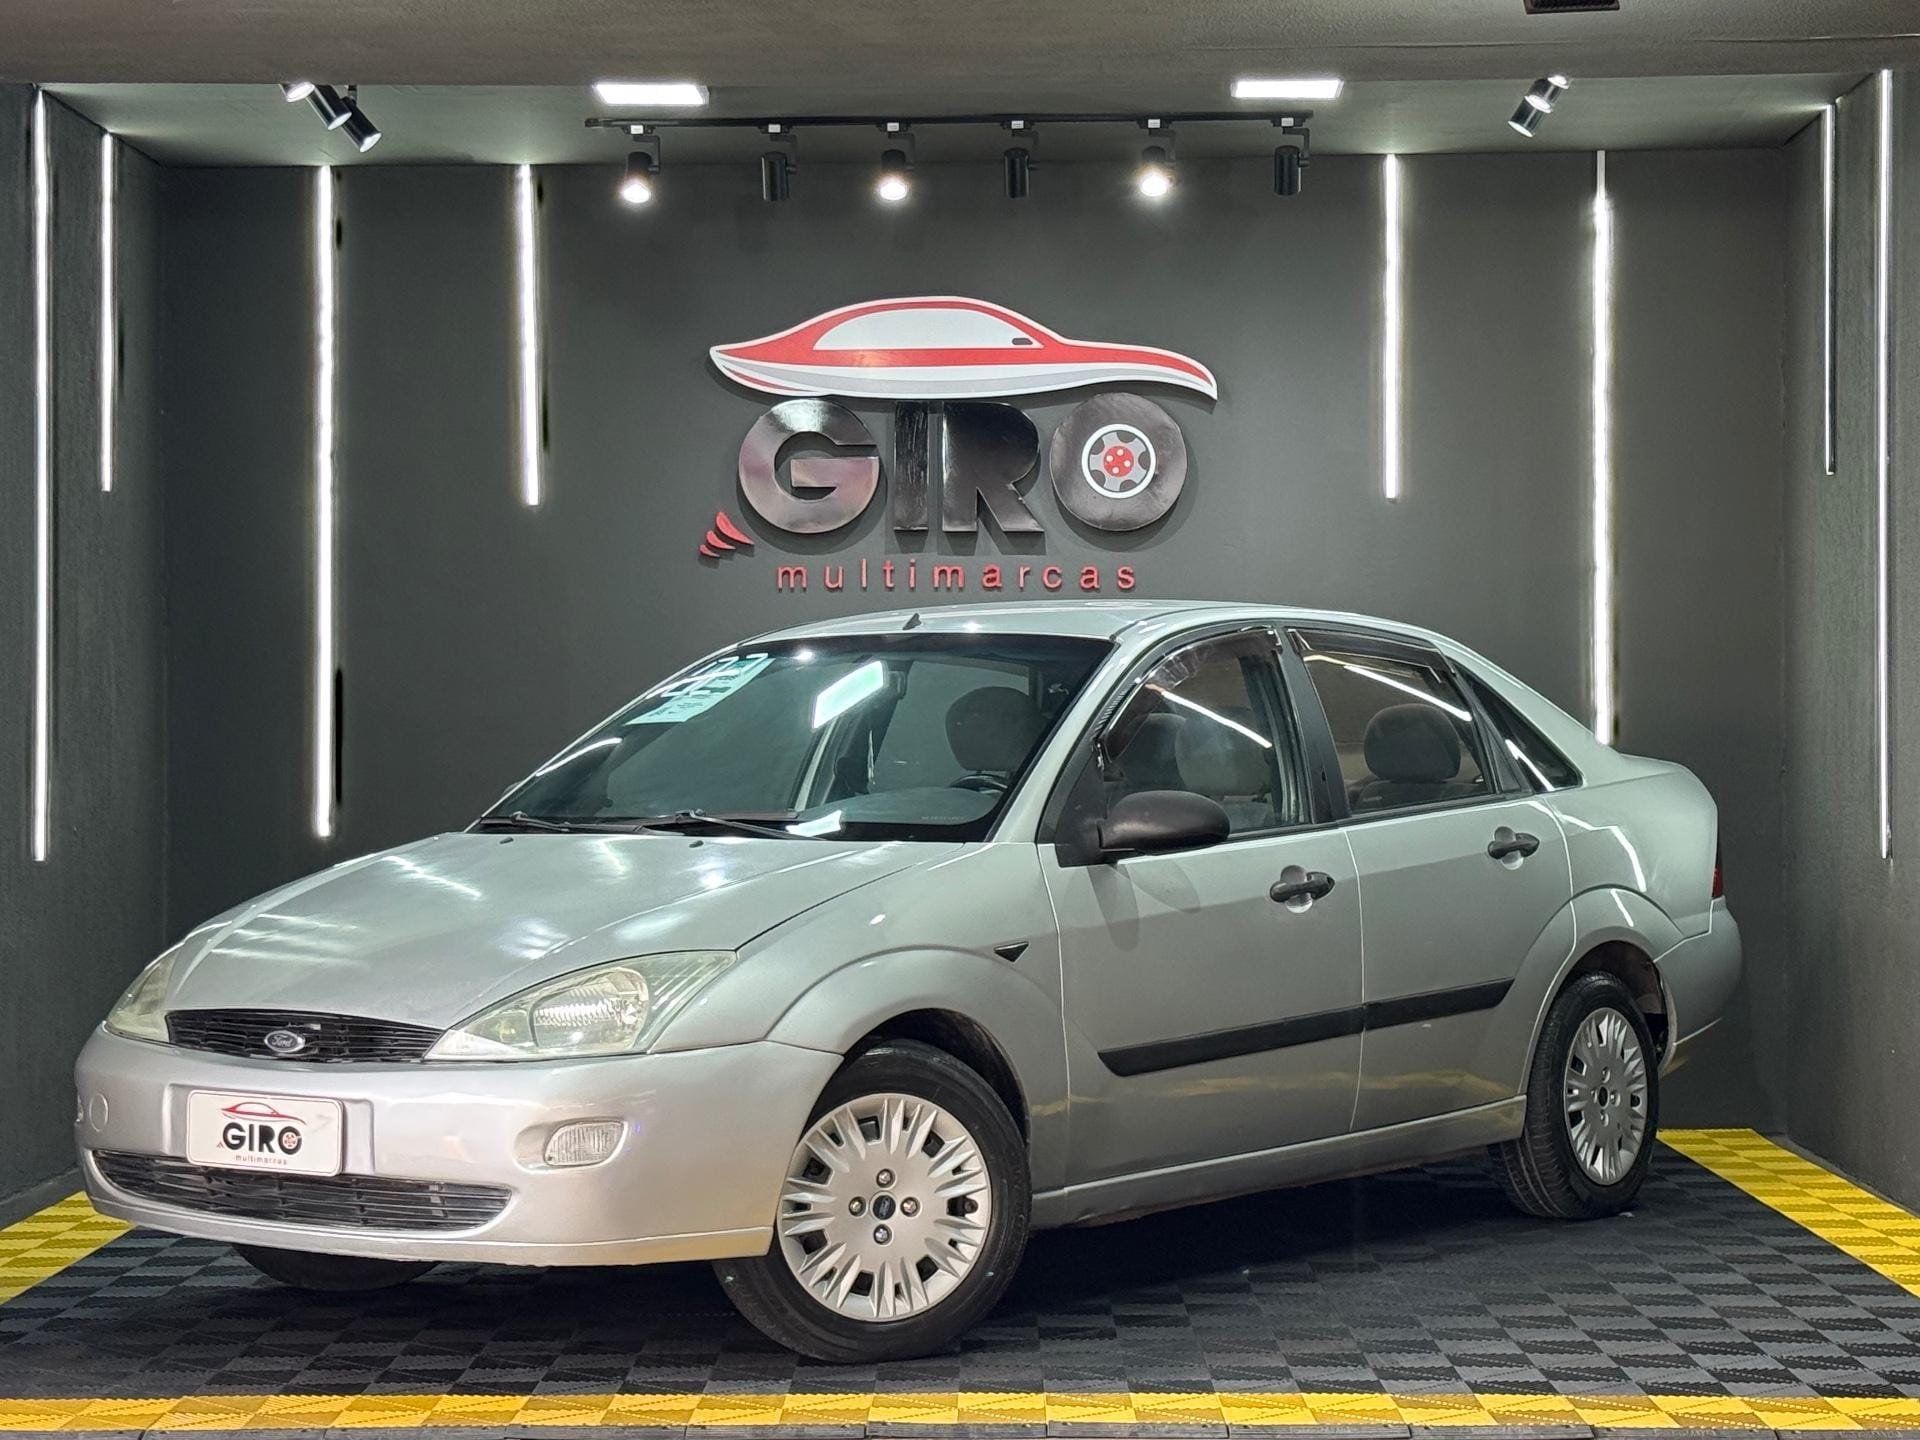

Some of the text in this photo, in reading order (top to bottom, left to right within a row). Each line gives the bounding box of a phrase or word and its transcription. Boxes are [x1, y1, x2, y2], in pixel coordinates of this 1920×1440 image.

[738, 392, 1187, 533] GIRO
[776, 559, 1136, 590] multimarcas
[223, 1122, 302, 1155] GIRO
